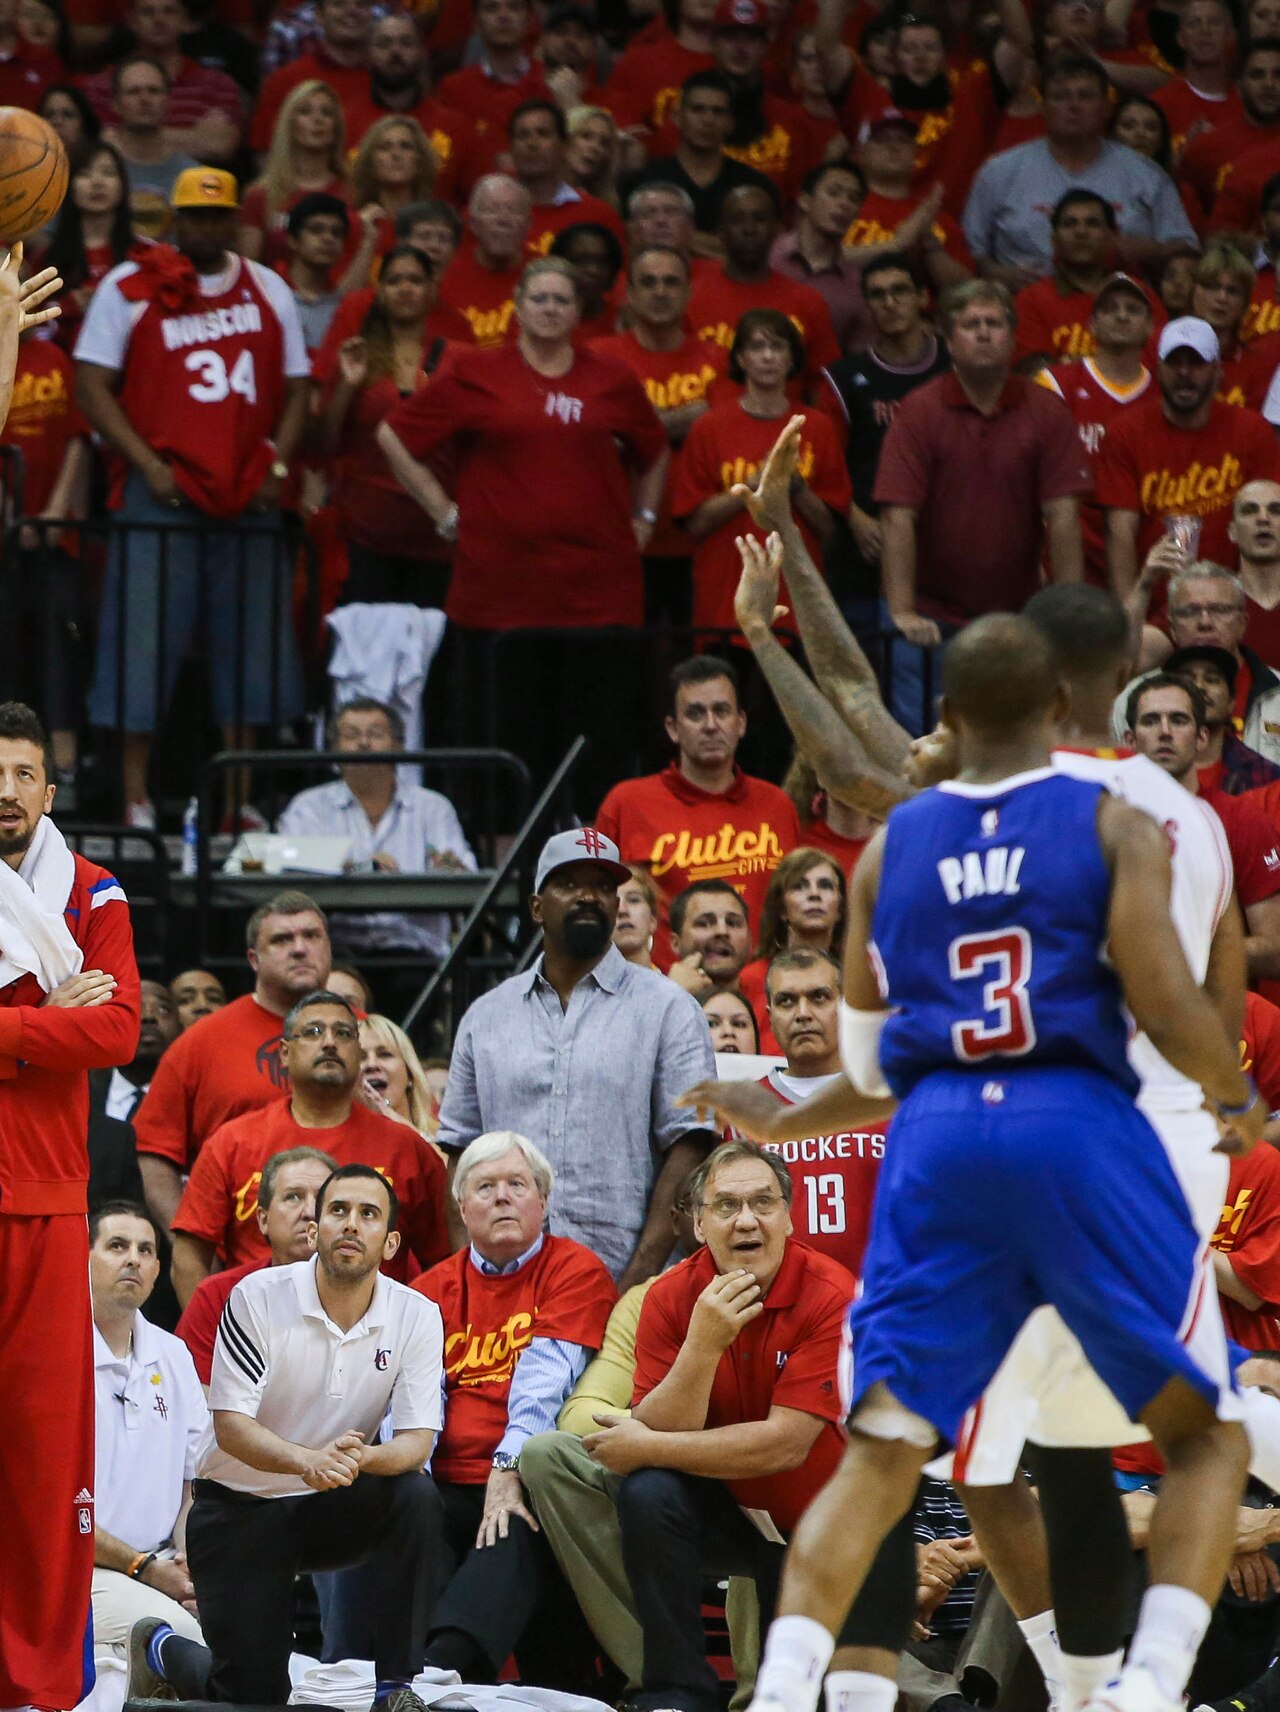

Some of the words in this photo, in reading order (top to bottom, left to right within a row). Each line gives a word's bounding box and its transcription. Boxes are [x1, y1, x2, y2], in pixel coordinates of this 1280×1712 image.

[184, 348, 257, 404] 34
[1140, 452, 1241, 513] Clutch
[651, 822, 784, 876] Clutch
[737, 856, 768, 876] CITY
[936, 846, 1026, 905] PAUL
[948, 926, 1037, 1064] 3
[802, 1172, 847, 1236] 13
